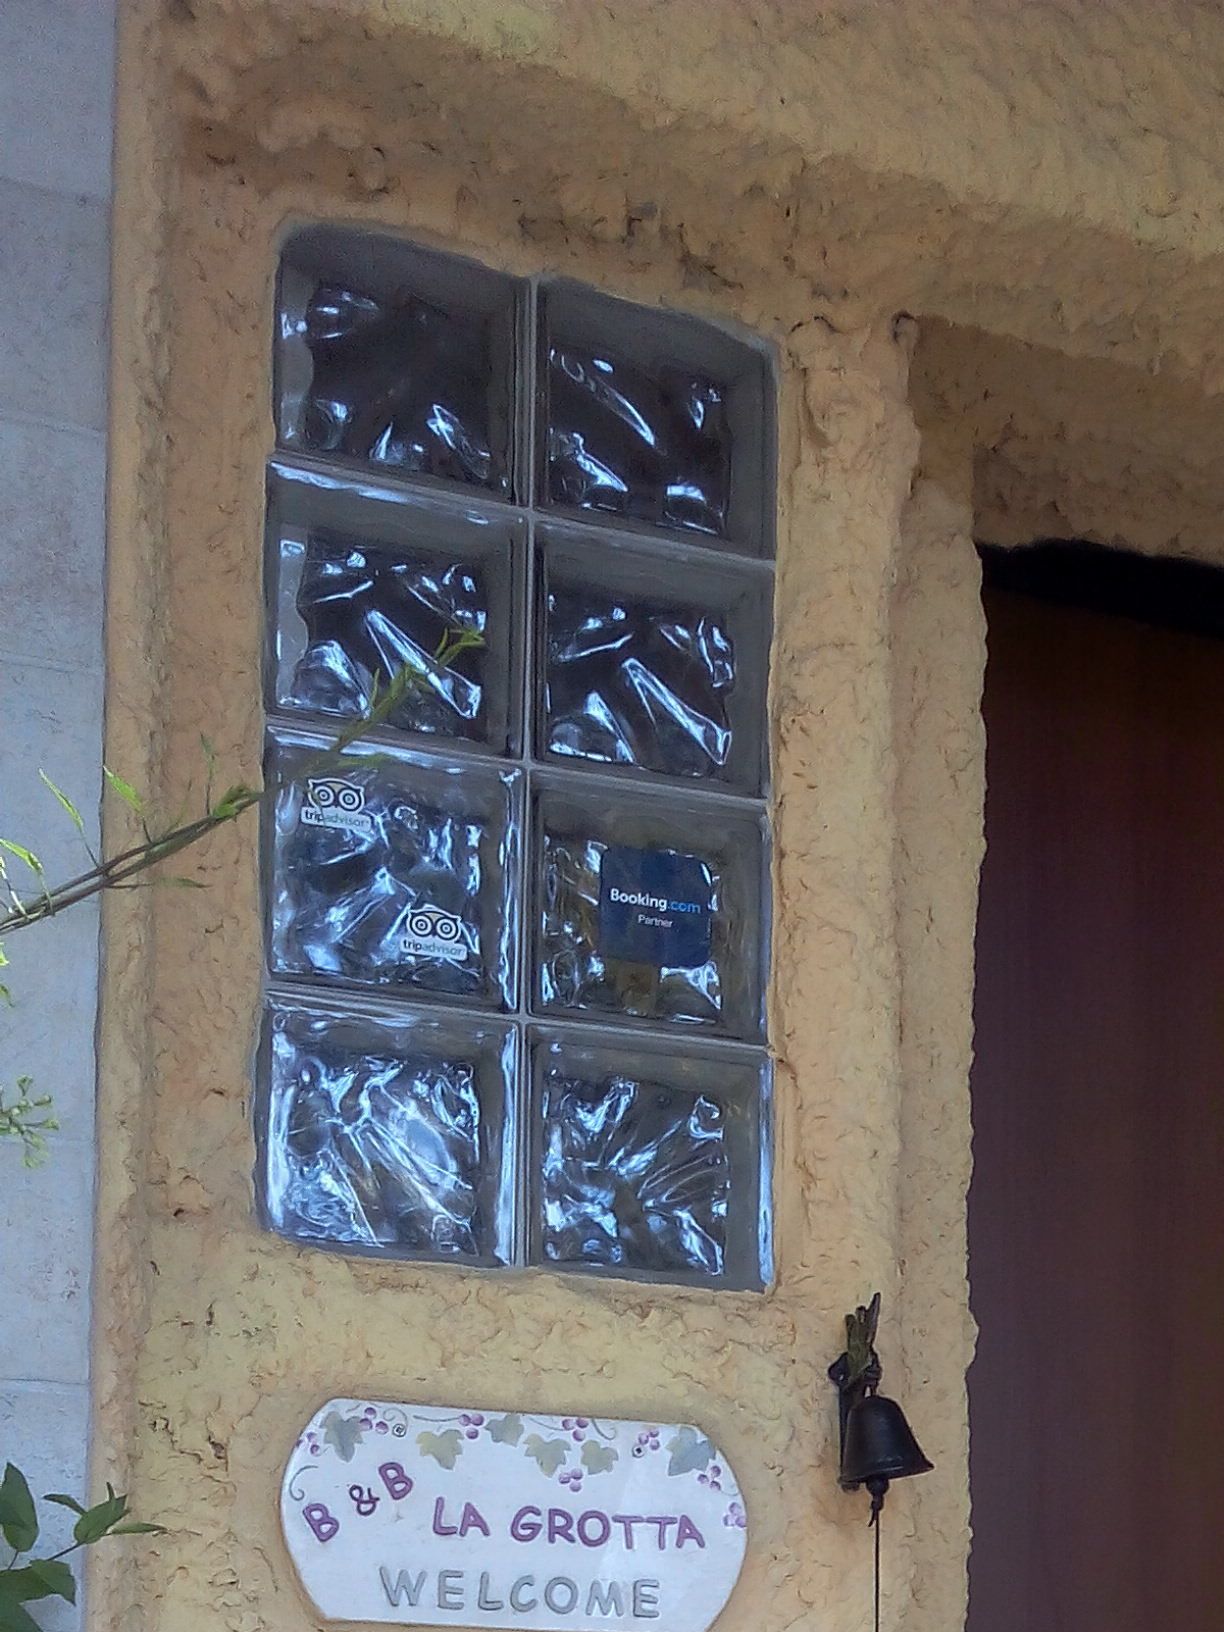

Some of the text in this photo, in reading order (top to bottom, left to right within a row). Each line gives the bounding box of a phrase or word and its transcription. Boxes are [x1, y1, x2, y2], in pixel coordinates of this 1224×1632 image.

[610, 888, 701, 914] Booking.com
[637, 914, 673, 927] Partner
[402, 938, 464, 957] tripadvisor
[432, 1497, 491, 1538] LA
[510, 1504, 706, 1550] GROTTA
[379, 1566, 661, 1619] WELCOME
